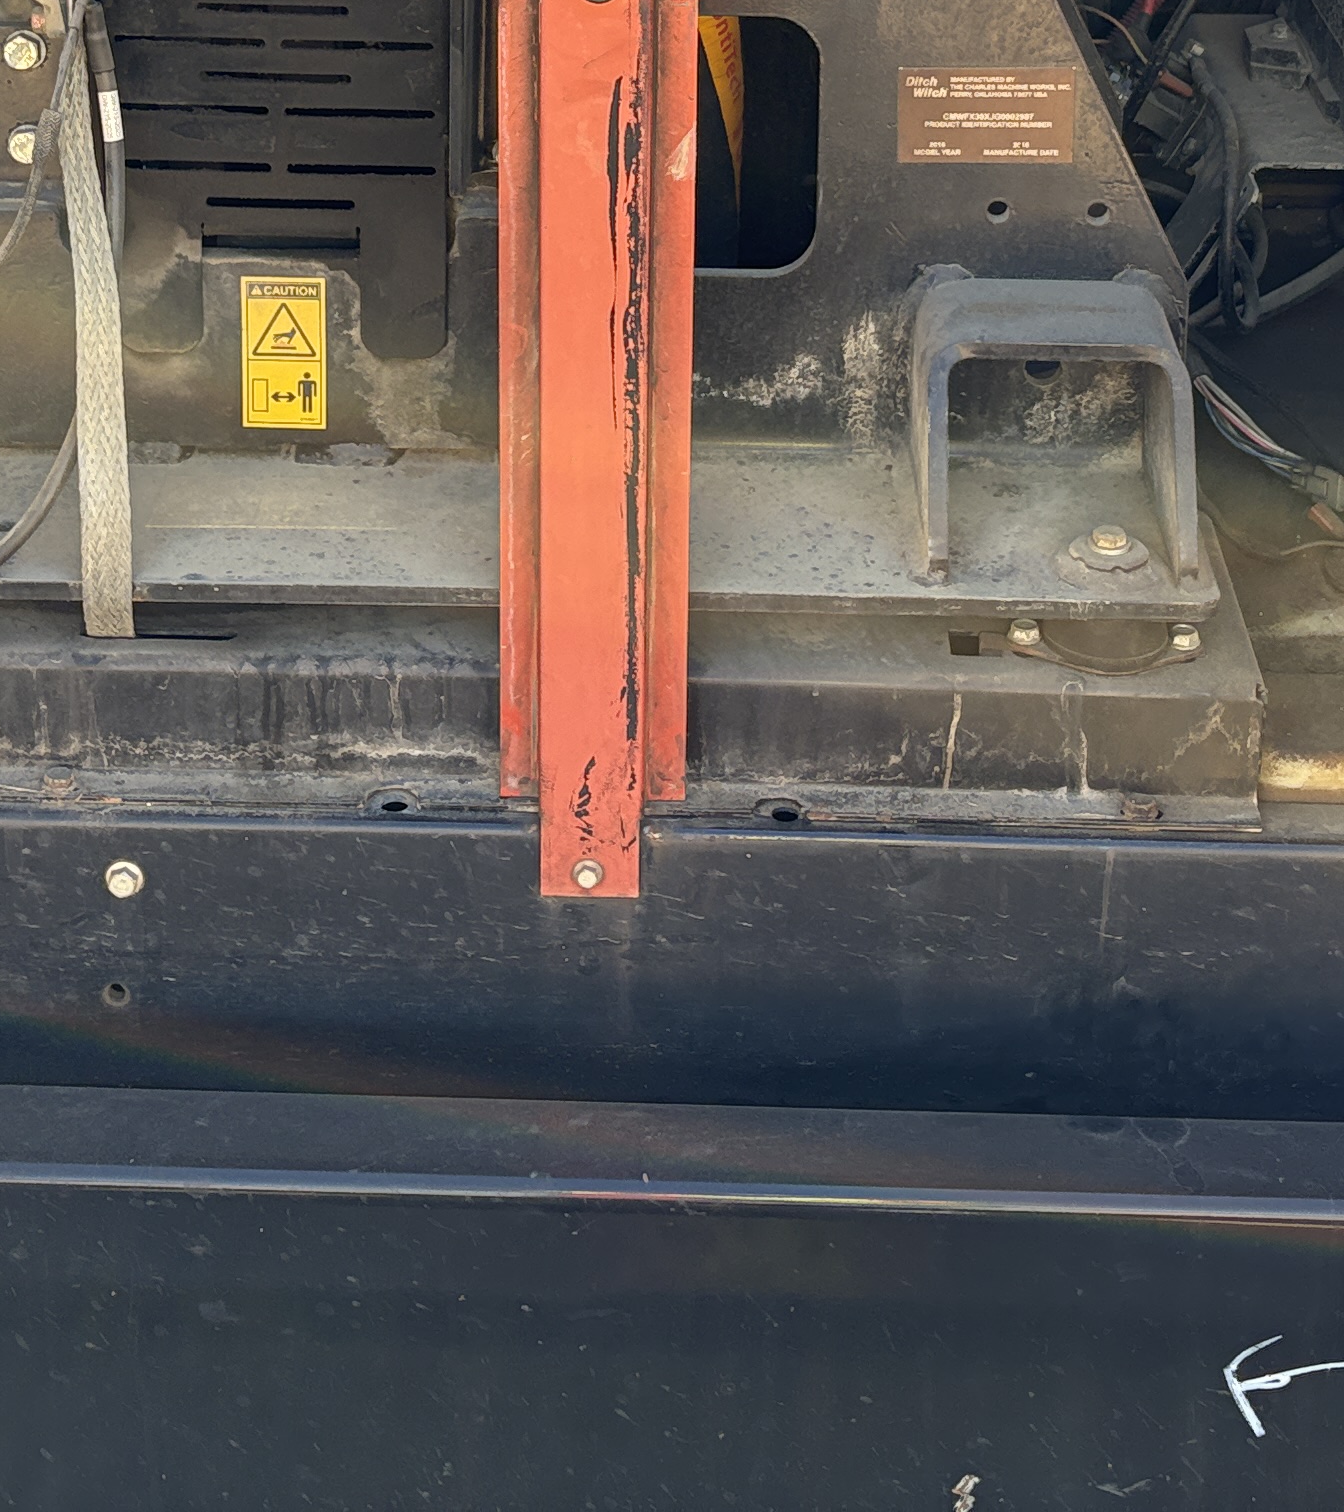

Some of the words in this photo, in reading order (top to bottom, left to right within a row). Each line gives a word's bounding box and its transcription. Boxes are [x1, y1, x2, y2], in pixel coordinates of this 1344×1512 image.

[905, 76, 938, 87] Ditch
[913, 87, 947, 98] Witch
[264, 286, 317, 296] CAUTION
